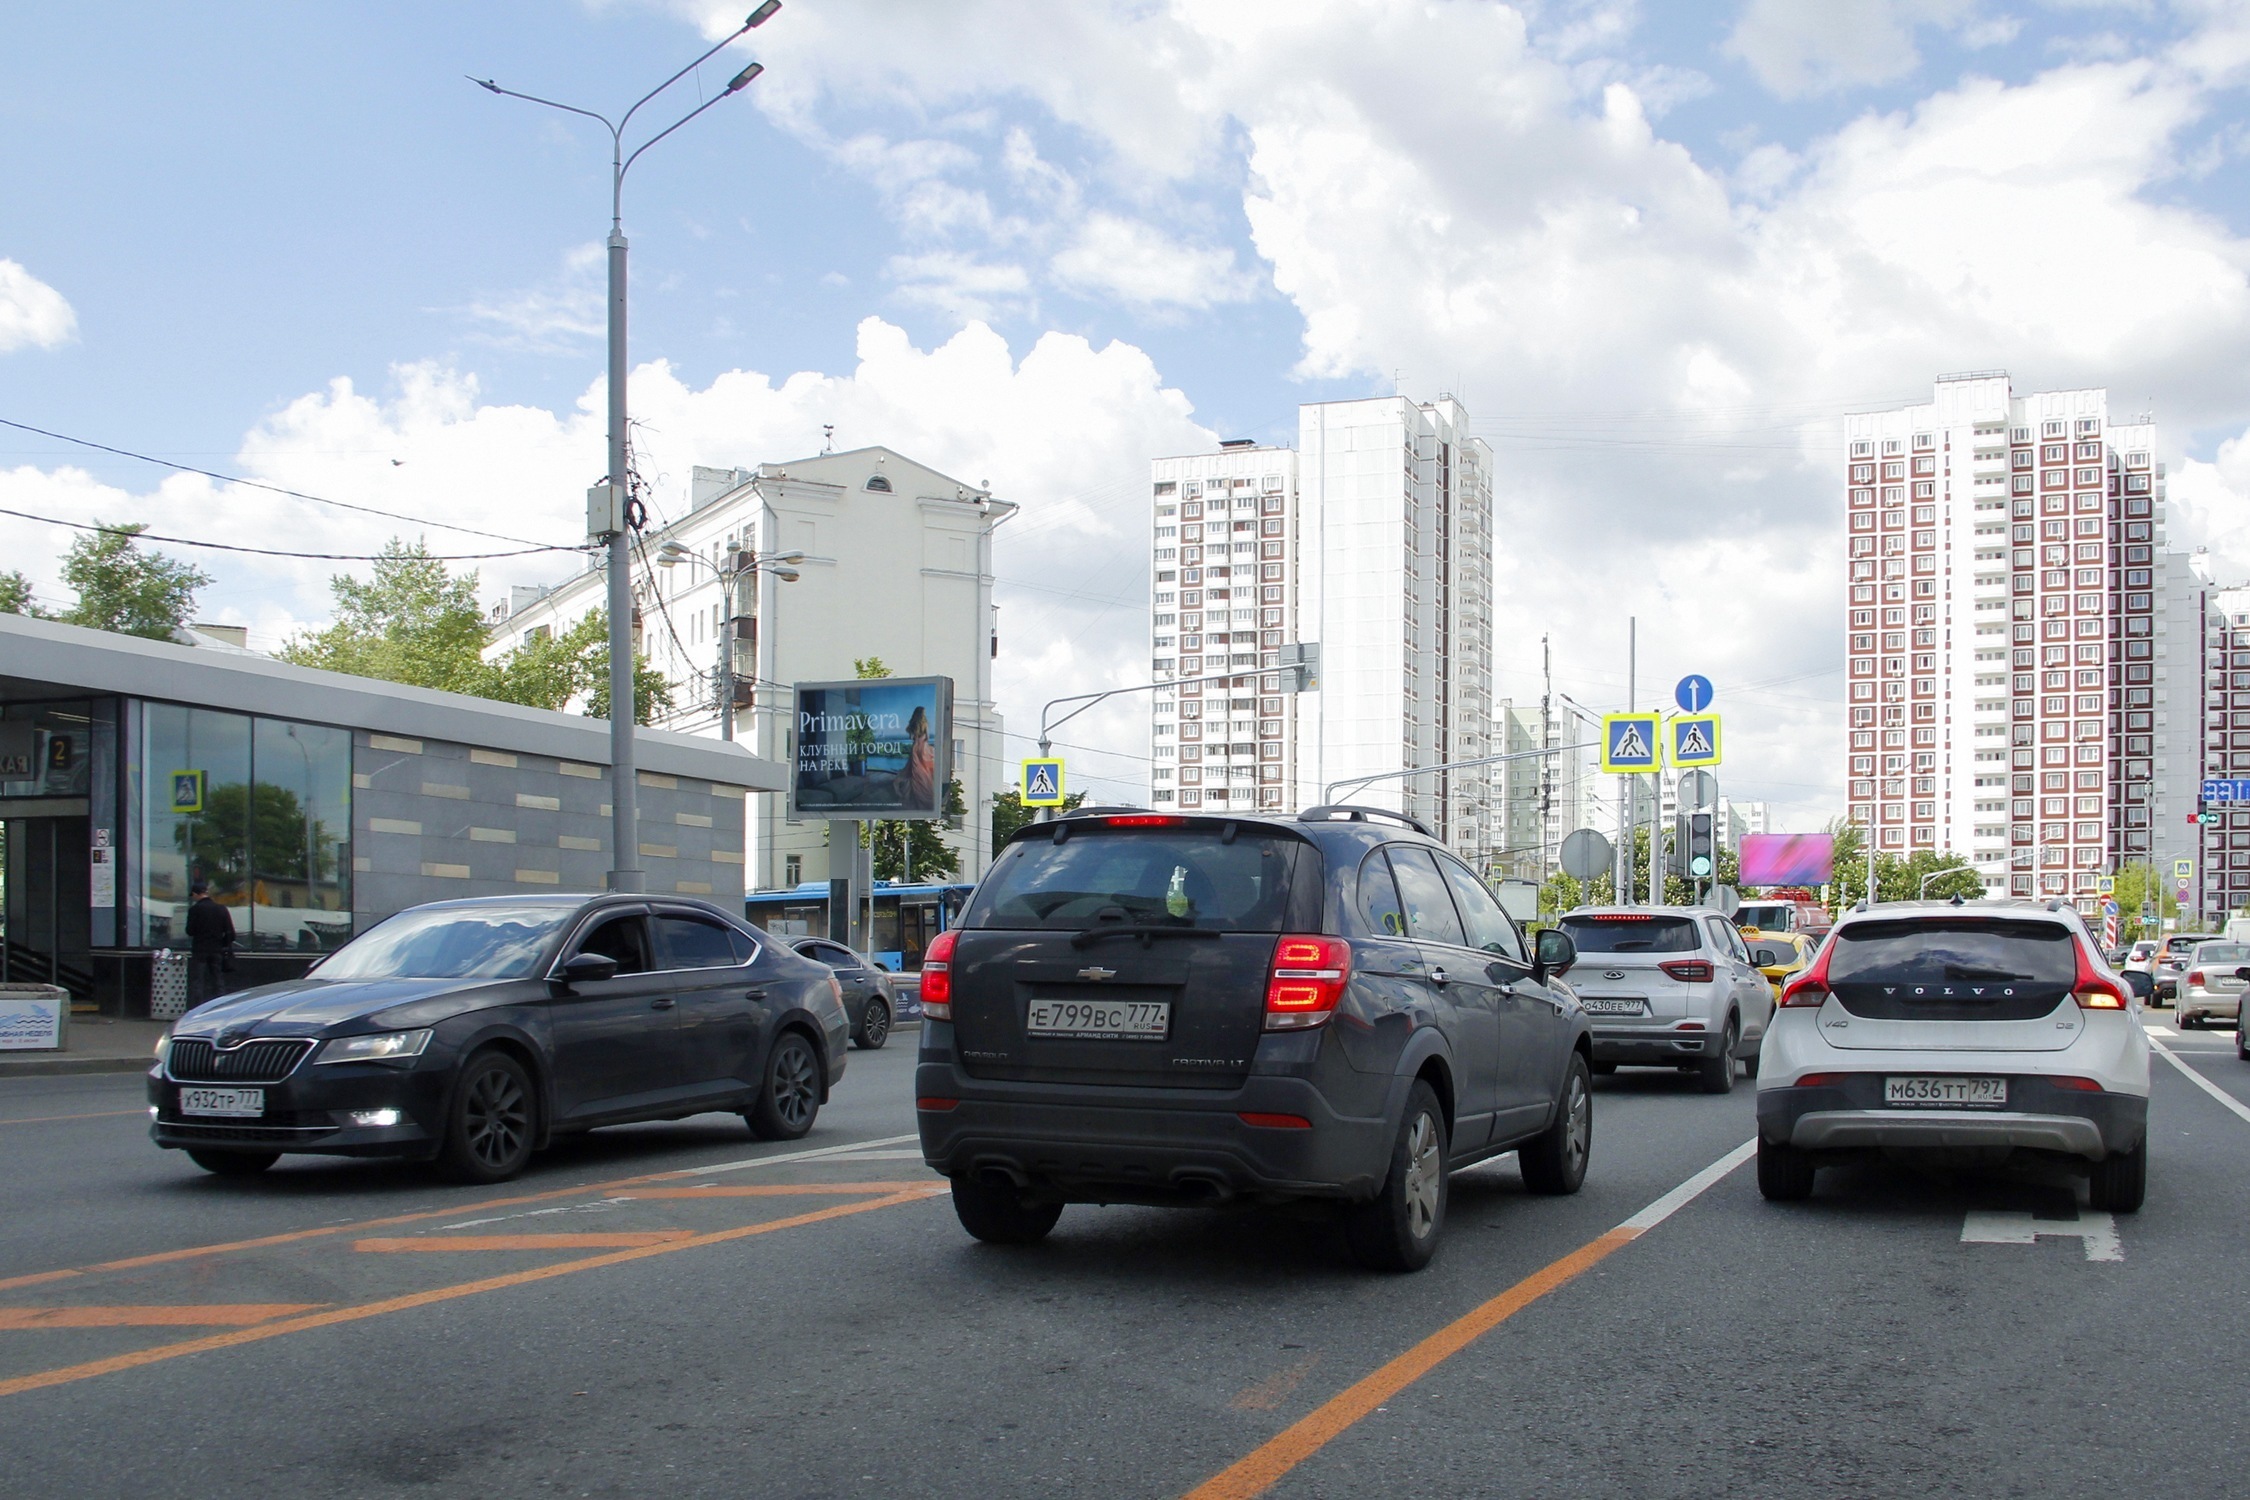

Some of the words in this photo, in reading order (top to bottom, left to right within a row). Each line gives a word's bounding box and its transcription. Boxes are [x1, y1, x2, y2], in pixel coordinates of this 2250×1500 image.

[800, 711, 900, 732] Primavera
[54, 741, 65, 760] 2
[800, 741, 858, 756] КЛУБНЫЙ
[861, 741, 902, 754] ГОРОД
[800, 760, 818, 771] НА
[820, 759, 848, 771] РЕКЕ
[1883, 987, 2013, 995] VOLVO
[1625, 1001, 1640, 1009] 977
[1128, 1004, 1162, 1023] 777
[1825, 1020, 1848, 1028] V40
[1971, 1080, 2000, 1095] 797
[238, 1090, 260, 1104] 777
